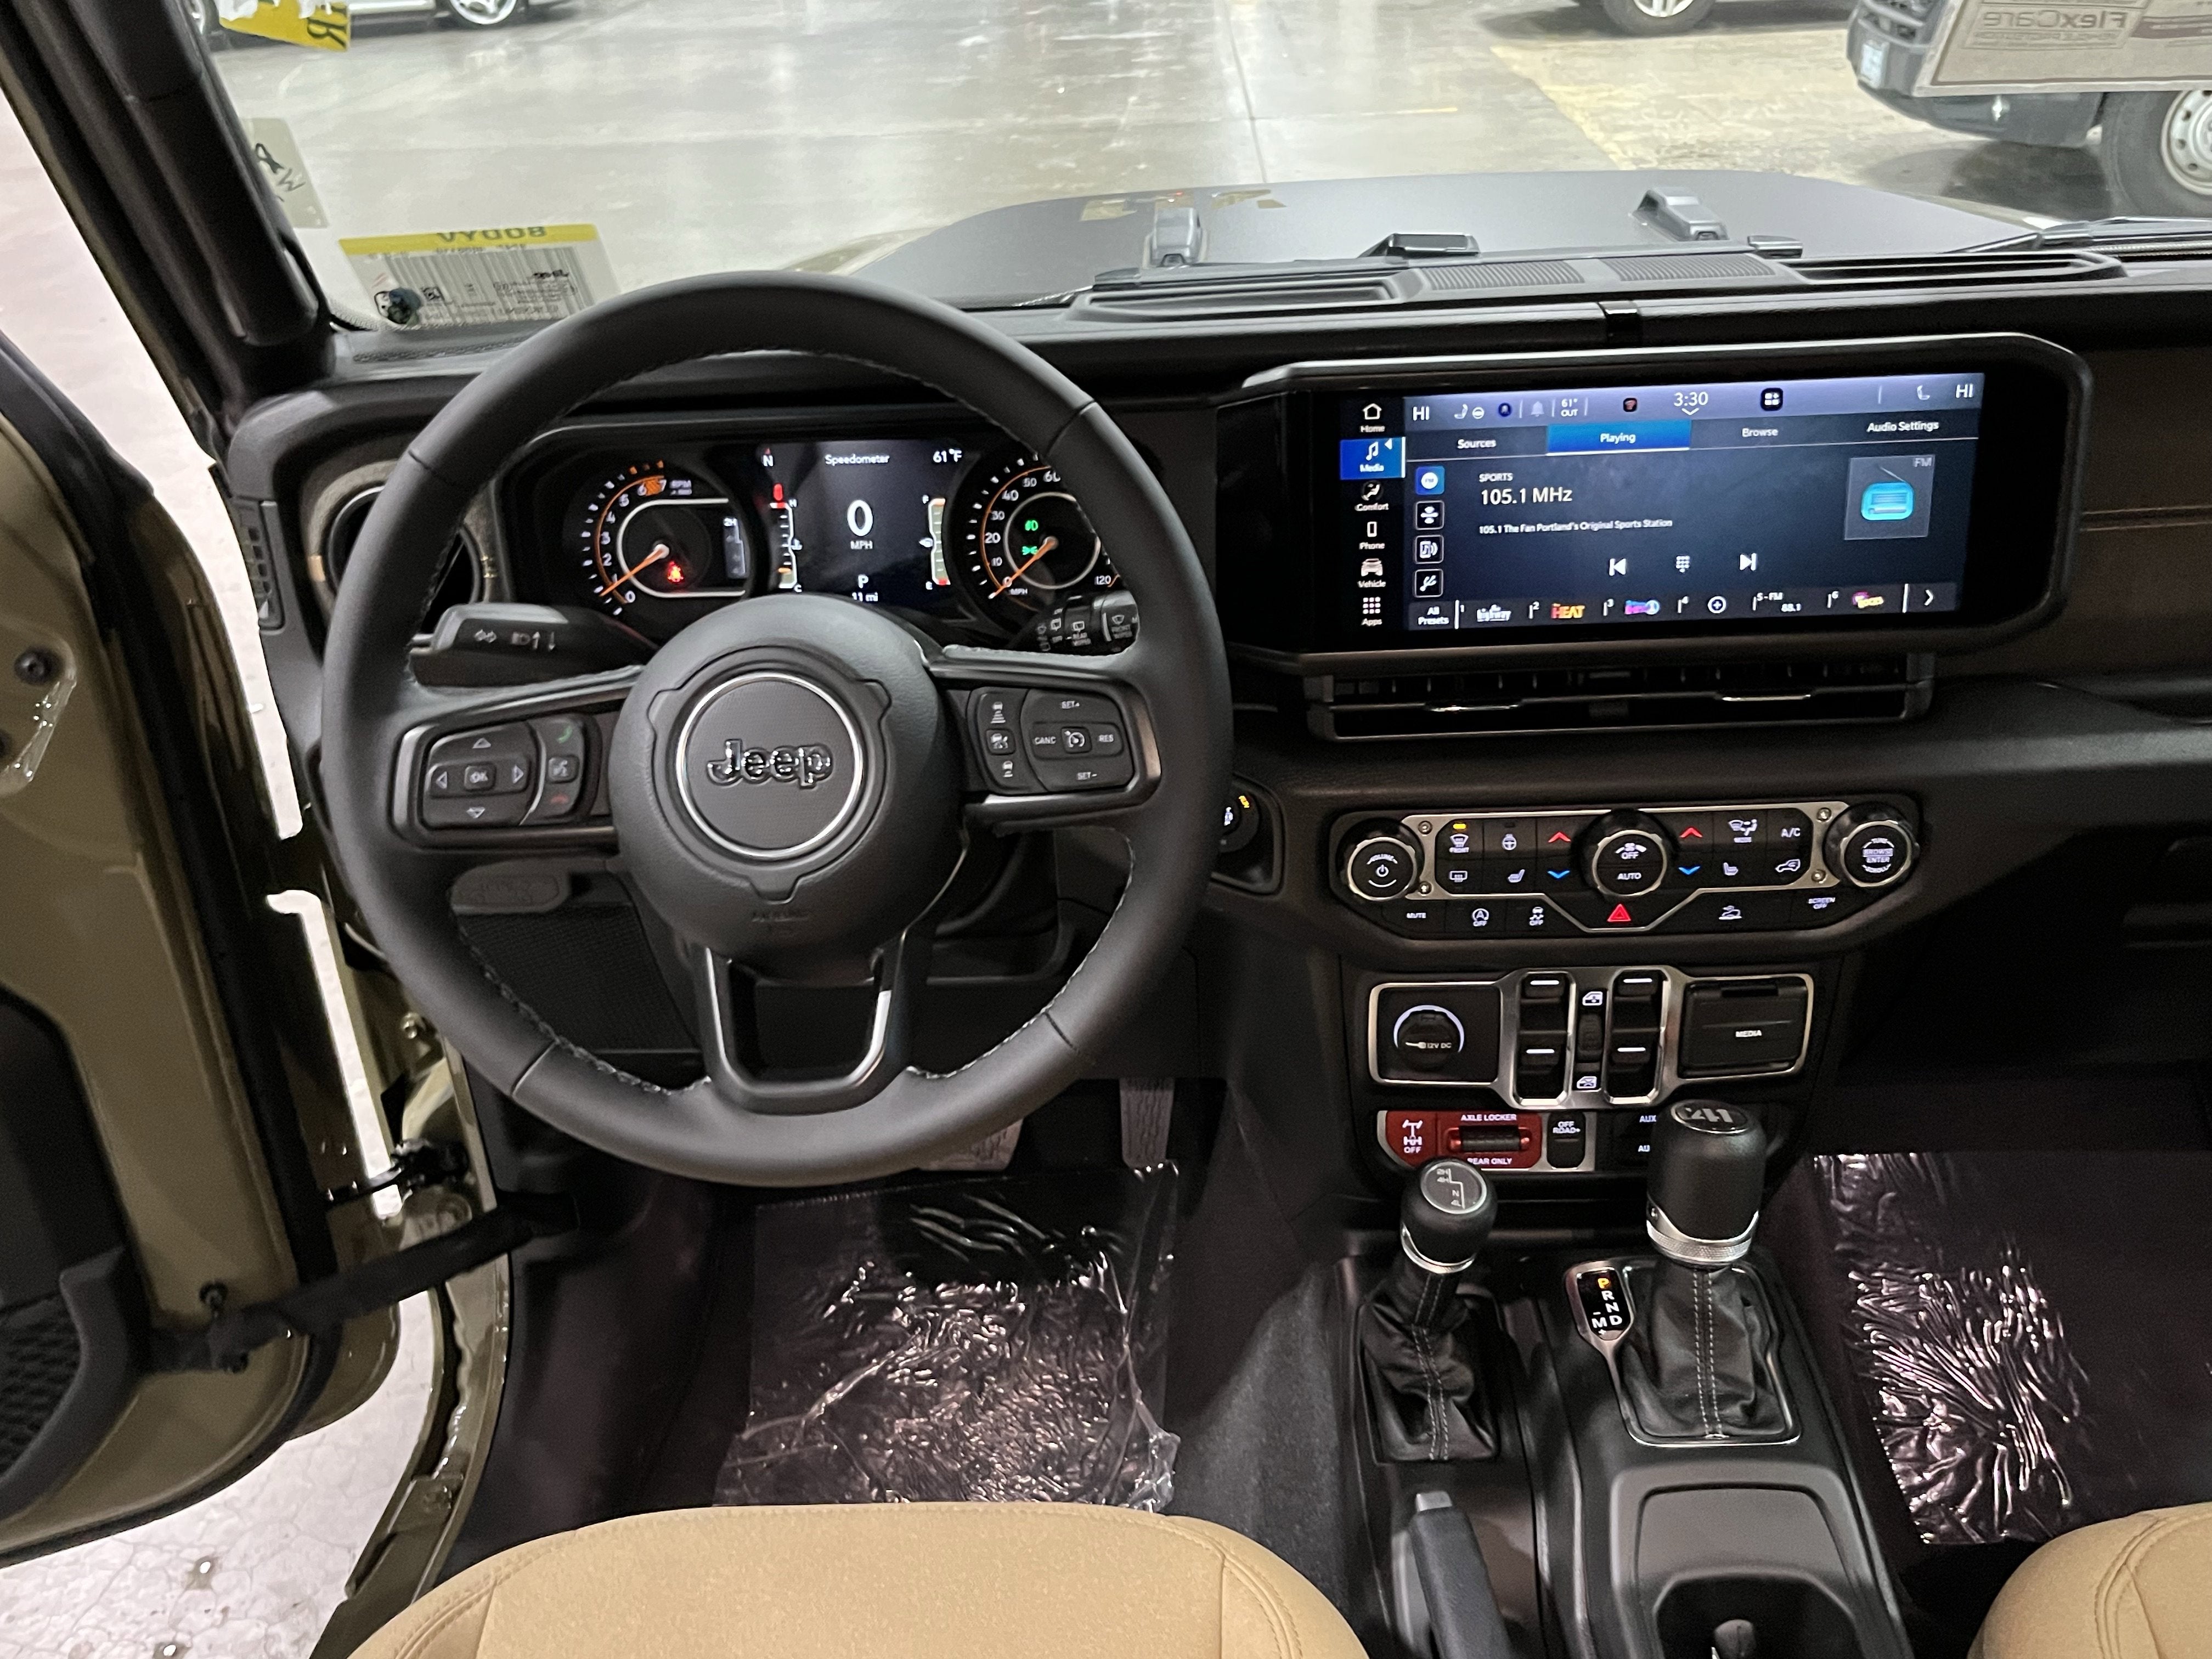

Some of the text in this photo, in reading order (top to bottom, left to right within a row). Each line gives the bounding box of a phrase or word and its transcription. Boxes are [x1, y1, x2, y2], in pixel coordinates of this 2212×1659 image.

[1955, 383, 1974, 399] HI
[1673, 391, 1708, 407] 3:30
[1412, 406, 1430, 421] HI
[1561, 409, 1578, 417] OUT
[1742, 427, 1779, 437] Browse
[1866, 421, 1939, 433] Audio Settings
[1600, 432, 1637, 444] Playing
[1457, 439, 1496, 449] Sources
[762, 455, 774, 466] N
[824, 454, 890, 466] Speedometer
[1914, 458, 1932, 467] FM
[1359, 464, 1384, 472] Media
[1022, 477, 1037, 487] 50
[1479, 472, 1513, 483] SPORTS
[637, 484, 646, 496] 6
[1001, 490, 1019, 501] 40
[619, 493, 629, 507] 5
[922, 496, 929, 504] F
[1481, 487, 1573, 505] 105.1 MHz
[788, 499, 797, 507] H
[1354, 503, 1389, 511] Comfort
[606, 511, 616, 524] 4
[847, 499, 873, 537] 0
[991, 510, 1005, 521] 30
[1479, 518, 1673, 534] 105.1 The Fan Portland's Original Sports Station
[600, 531, 611, 545] 3
[985, 532, 1001, 543] 20
[850, 540, 873, 550] MPH
[1359, 542, 1385, 550] Phone
[602, 553, 612, 566] 2
[991, 557, 1002, 566] 10
[857, 575, 869, 589] P
[1095, 575, 1111, 585] 120
[1357, 580, 1386, 589] Vehicle
[793, 584, 802, 593] C
[926, 582, 933, 590] E
[625, 590, 636, 602] 0
[851, 592, 878, 602] 11 mi
[1532, 601, 1540, 610] 2
[1607, 599, 1614, 607] 3
[1427, 606, 1440, 615] All
[1551, 606, 1585, 618] HEAT
[1361, 618, 1383, 627] Apps
[1418, 616, 1449, 625] Presets
[1034, 736, 1057, 745] CANC
[706, 738, 834, 790] Jeep
[470, 771, 488, 783] OK
[1781, 828, 1801, 837] A/C
[1621, 851, 1639, 860] OFF
[1598, 1278, 1610, 1289] P
[1601, 1290, 1615, 1301] R
[1605, 1302, 1620, 1313] N
[1591, 1315, 1623, 1329] M D
